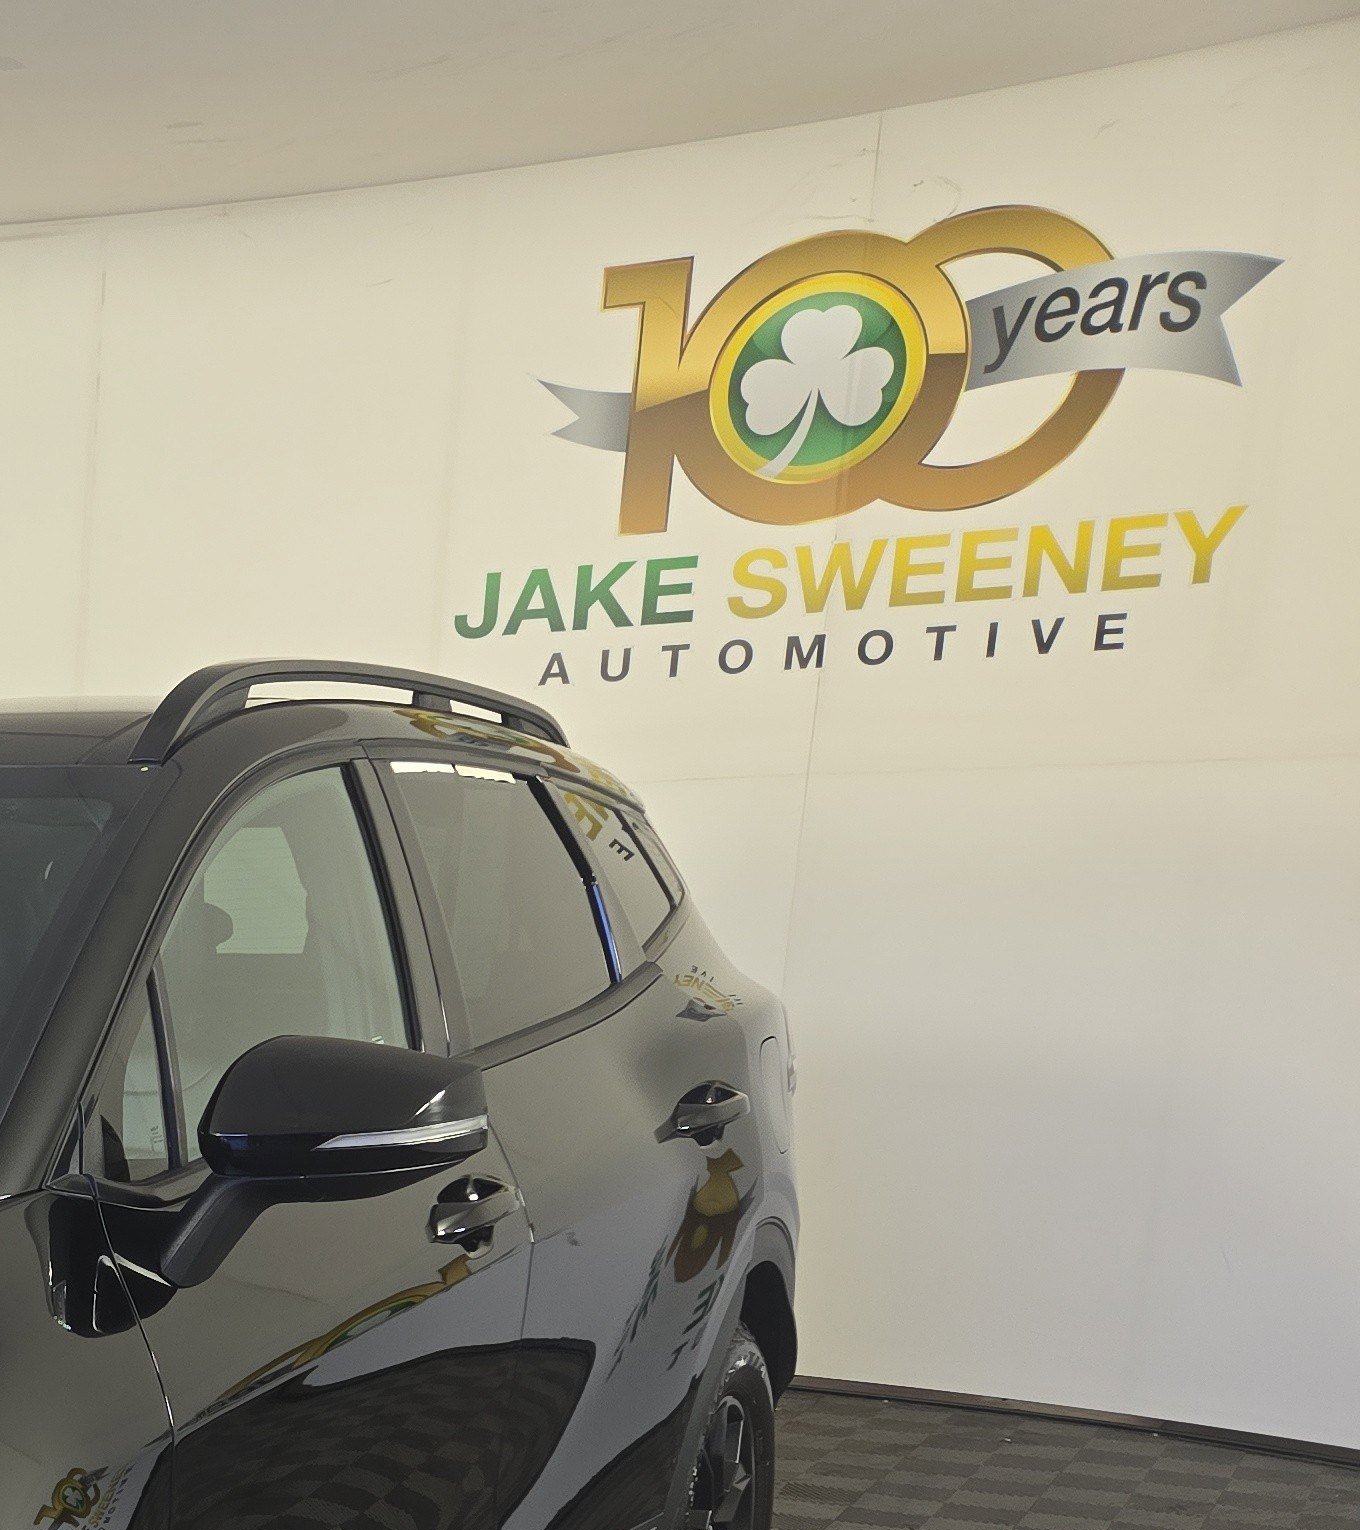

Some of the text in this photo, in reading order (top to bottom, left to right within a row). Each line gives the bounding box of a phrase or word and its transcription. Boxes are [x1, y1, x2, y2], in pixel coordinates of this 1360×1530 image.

[601, 204, 1206, 537] 100 years
[454, 505, 1247, 639] JAKE SWEENEY
[537, 612, 1128, 686] AUTOMOTIVE
